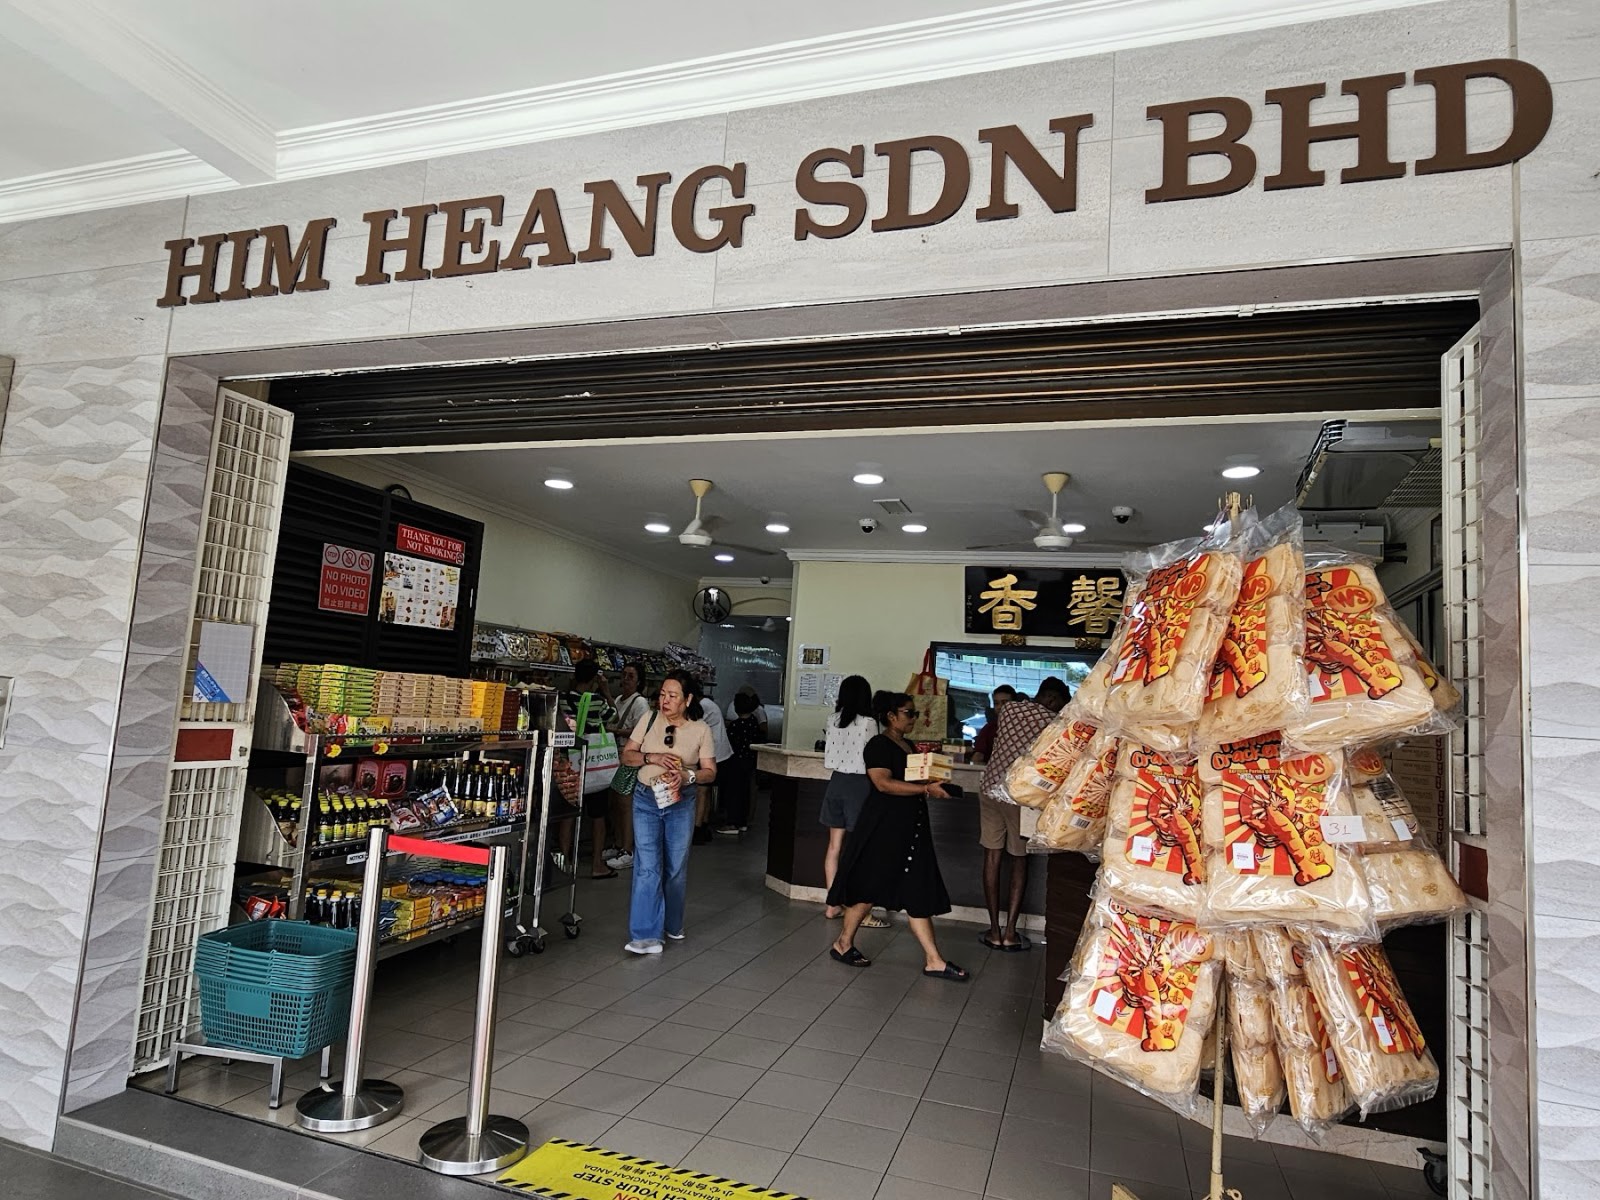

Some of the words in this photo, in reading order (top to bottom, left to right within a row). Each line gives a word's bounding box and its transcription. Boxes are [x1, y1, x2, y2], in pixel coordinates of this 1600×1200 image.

[157, 217, 337, 307] HIM
[355, 164, 756, 286] HEANG
[795, 118, 1094, 241] SDN
[1146, 58, 1553, 204] BHD
[401, 528, 429, 544] THANK
[432, 536, 446, 549] YOU
[448, 540, 462, 553] FOR
[407, 540, 421, 552] NOT
[424, 545, 457, 561] SMOKING
[326, 570, 338, 581] NO
[340, 574, 367, 586] PHOTO
[325, 584, 338, 595] NO
[340, 585, 366, 599] VIDEO
[1333, 588, 1370, 608] WS
[1291, 753, 1326, 777] WS
[1328, 821, 1351, 836] 31
[584, 1164, 612, 1174] ANDA
[573, 1172, 615, 1186] STEP
[613, 1171, 660, 1187] LANGKAH
[616, 1182, 658, 1199] YOUR
